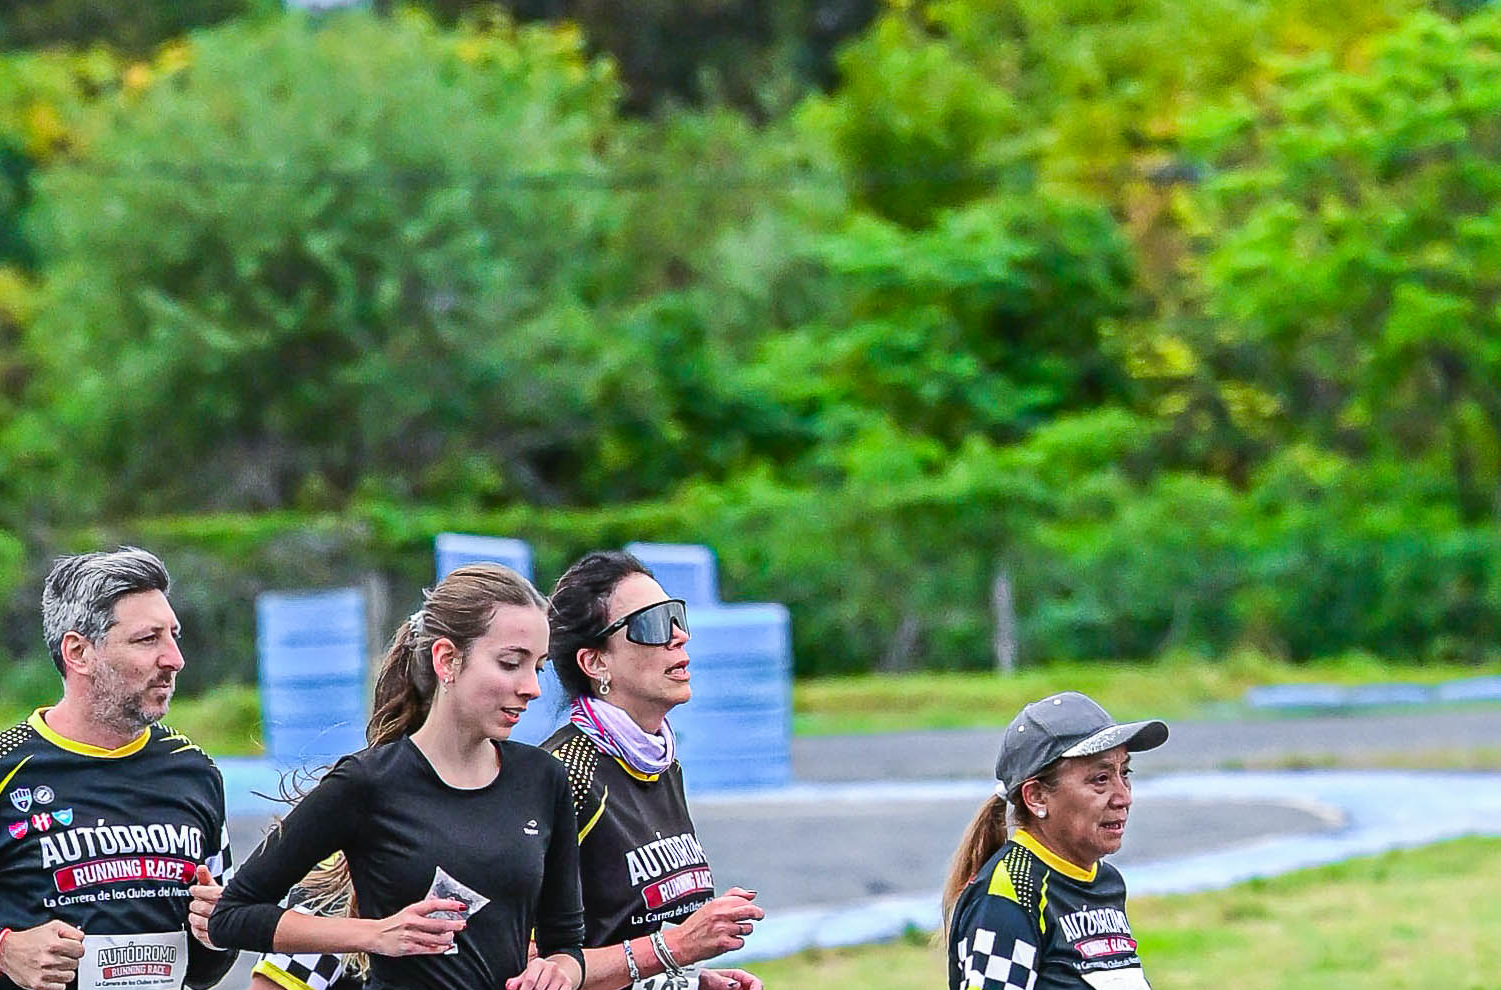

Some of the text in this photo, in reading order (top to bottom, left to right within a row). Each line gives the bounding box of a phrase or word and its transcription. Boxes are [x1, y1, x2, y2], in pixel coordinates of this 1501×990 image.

[40, 818, 202, 869] AUTÓDROMO
[73, 858, 185, 887] RUNNING RACE
[43, 897, 57, 908] La
[58, 894, 97, 906] Carrera
[97, 890, 111, 901] de
[112, 889, 126, 900] los
[127, 887, 156, 899] Clubes
[158, 886, 170, 897] del
[631, 915, 644, 925] La
[645, 910, 675, 922] Carrera
[98, 941, 177, 967] AUTÓDROMO
[111, 964, 167, 978] RUNNING RACE
